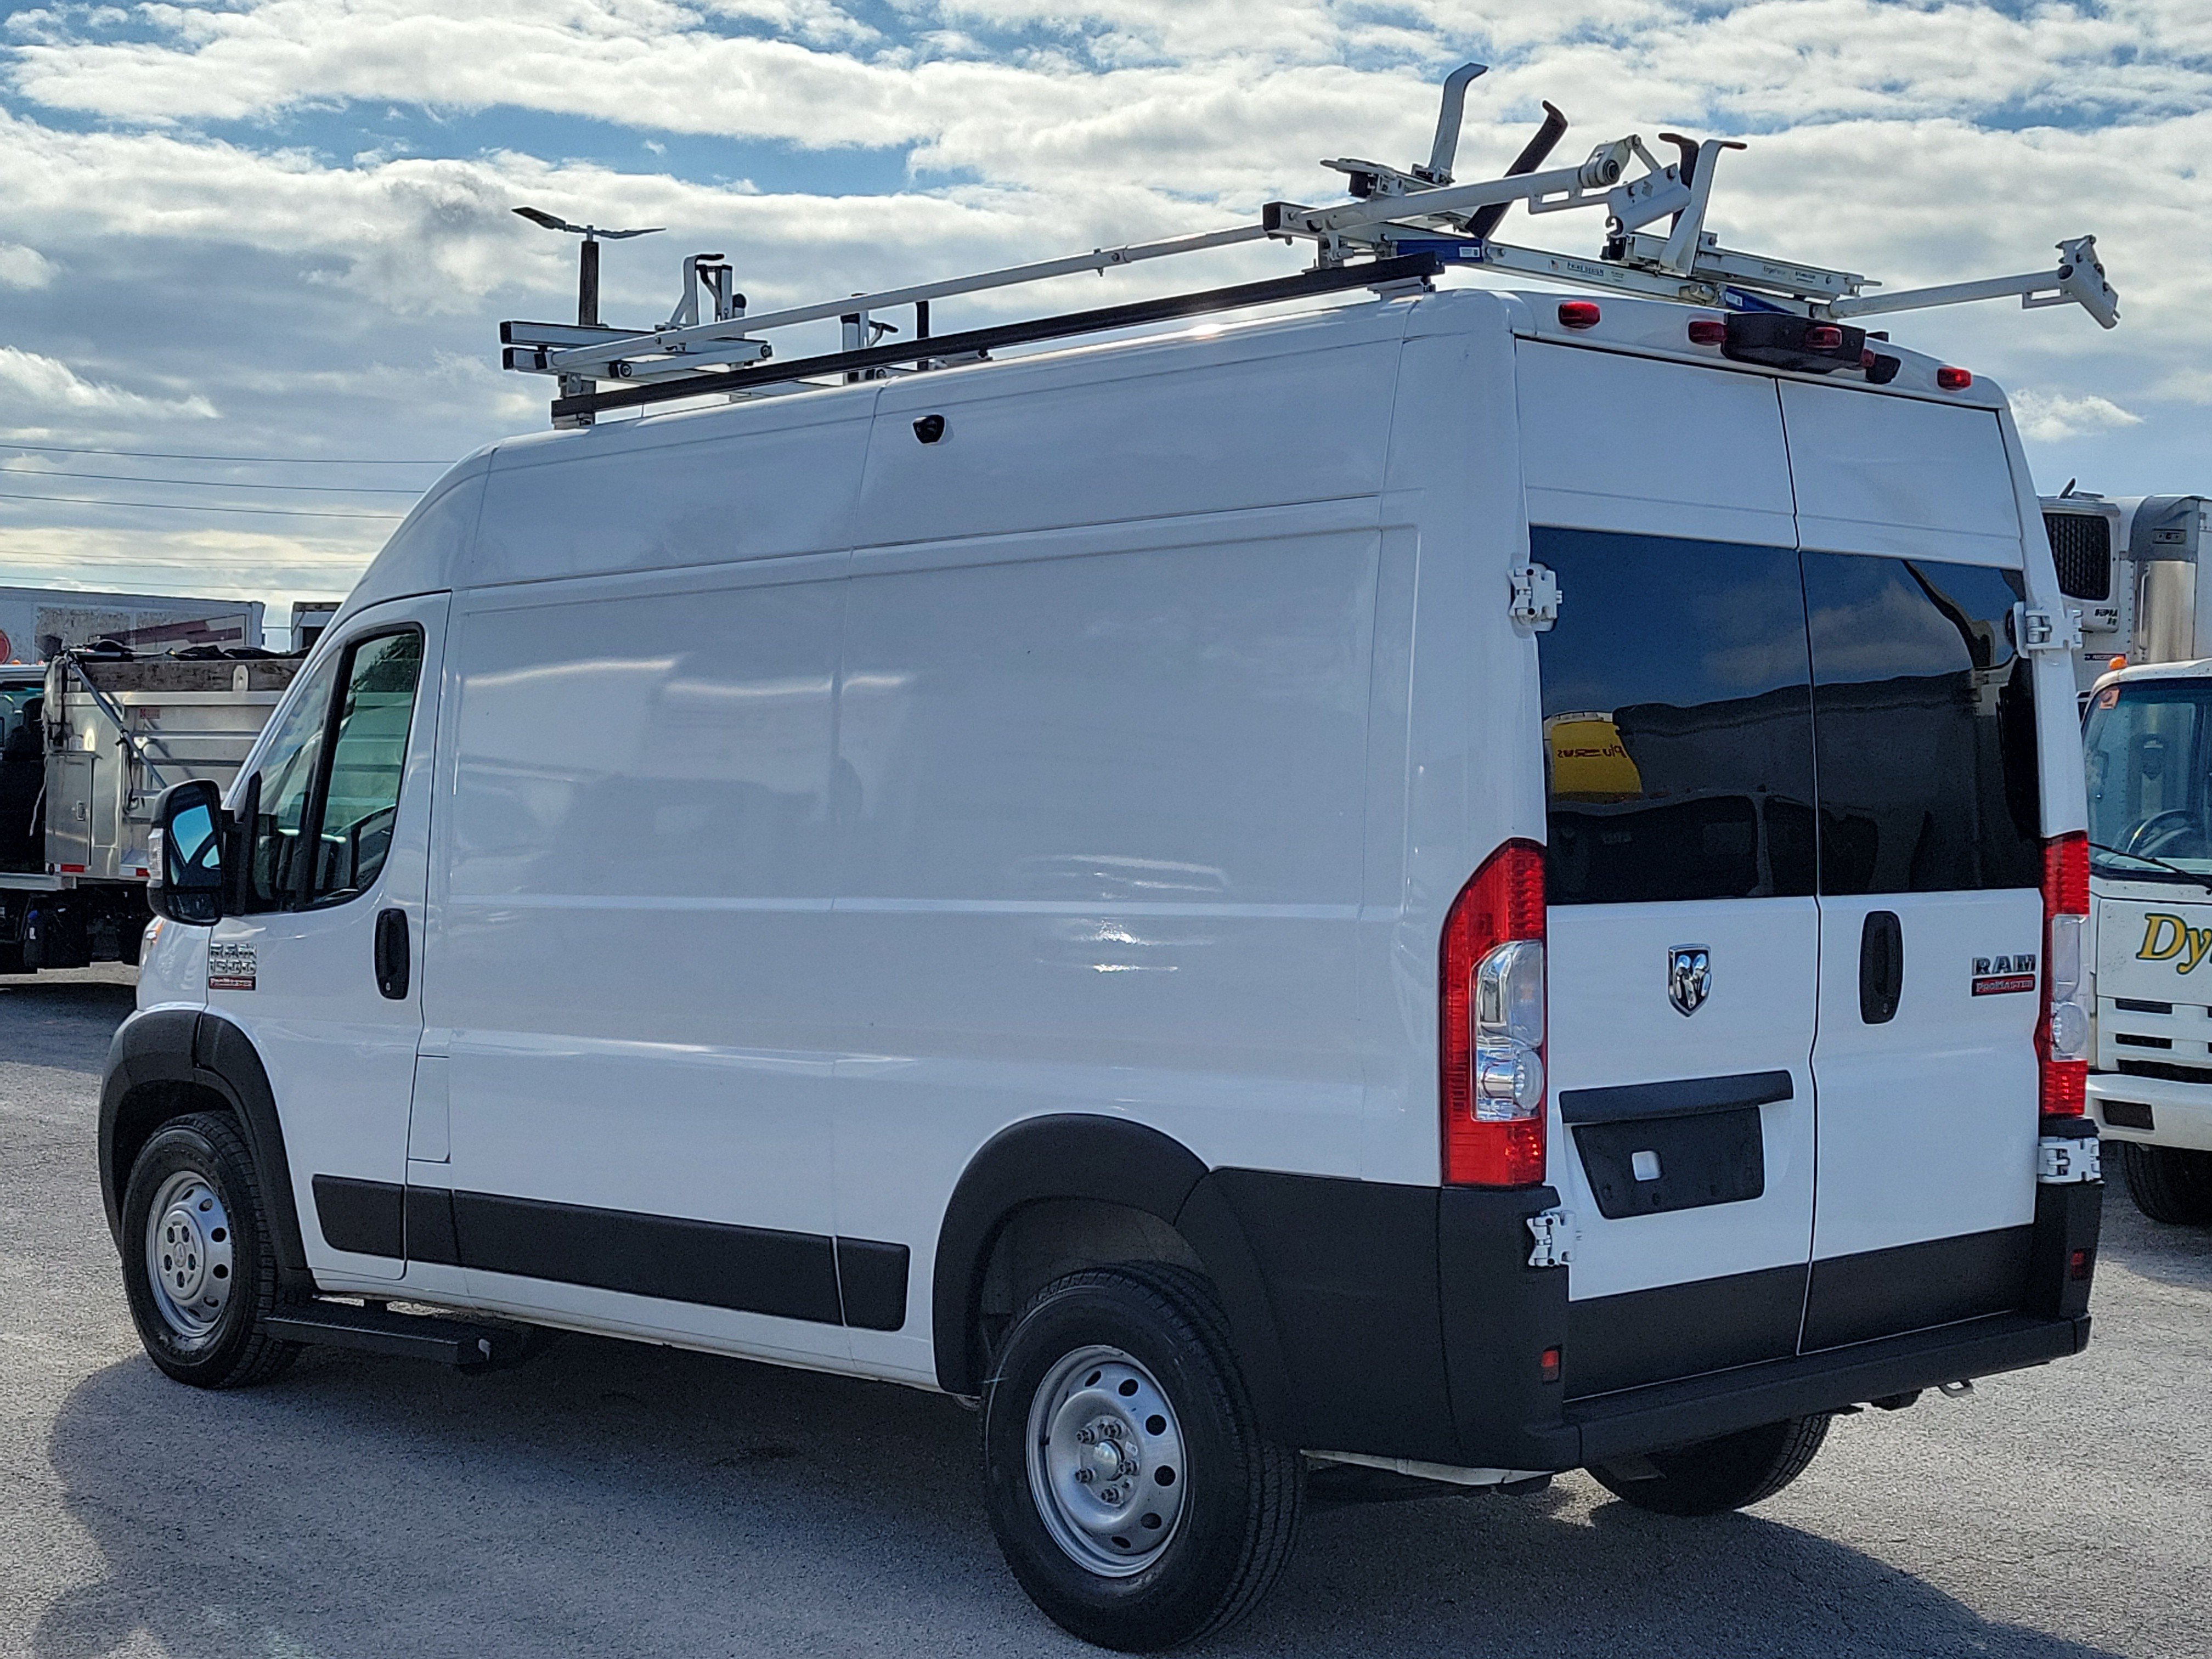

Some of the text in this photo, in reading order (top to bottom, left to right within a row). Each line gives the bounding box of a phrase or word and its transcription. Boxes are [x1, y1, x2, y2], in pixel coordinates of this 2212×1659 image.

[210, 943, 257, 958] RAM
[2136, 912, 2212, 975] Dy
[1972, 955, 2036, 976] RAM
